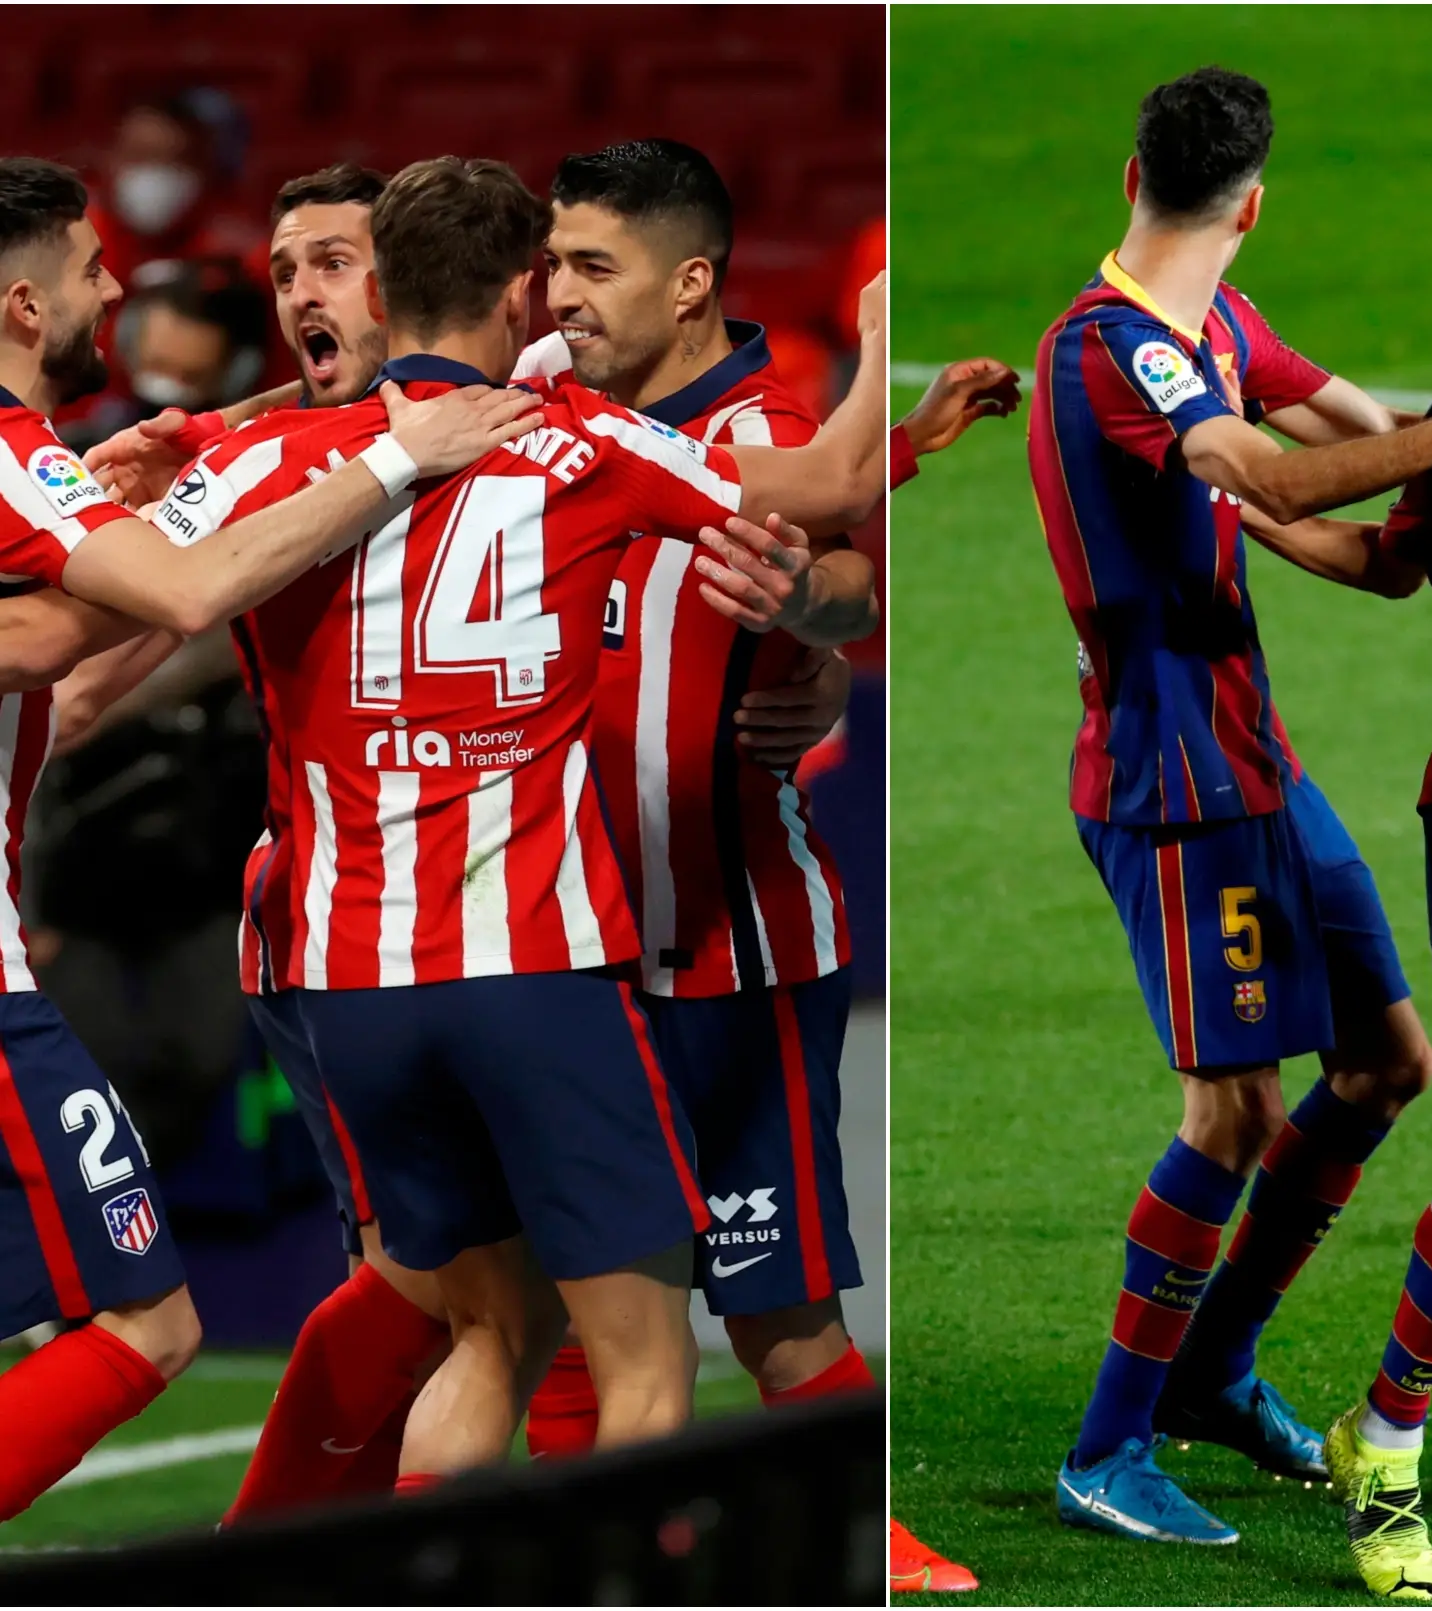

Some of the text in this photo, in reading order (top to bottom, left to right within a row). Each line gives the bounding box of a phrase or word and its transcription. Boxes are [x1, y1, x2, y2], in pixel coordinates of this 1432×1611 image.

[1158, 376, 1198, 404] LaLiga
[500, 426, 596, 485] NTE
[57, 485, 102, 507] LaLiga
[158, 501, 198, 540] NDAI
[348, 475, 562, 711] 14
[365, 715, 524, 767] ria Money
[459, 747, 535, 767] Transfer
[1218, 886, 1263, 972] 5
[705, 1228, 781, 1246] VERSUS
